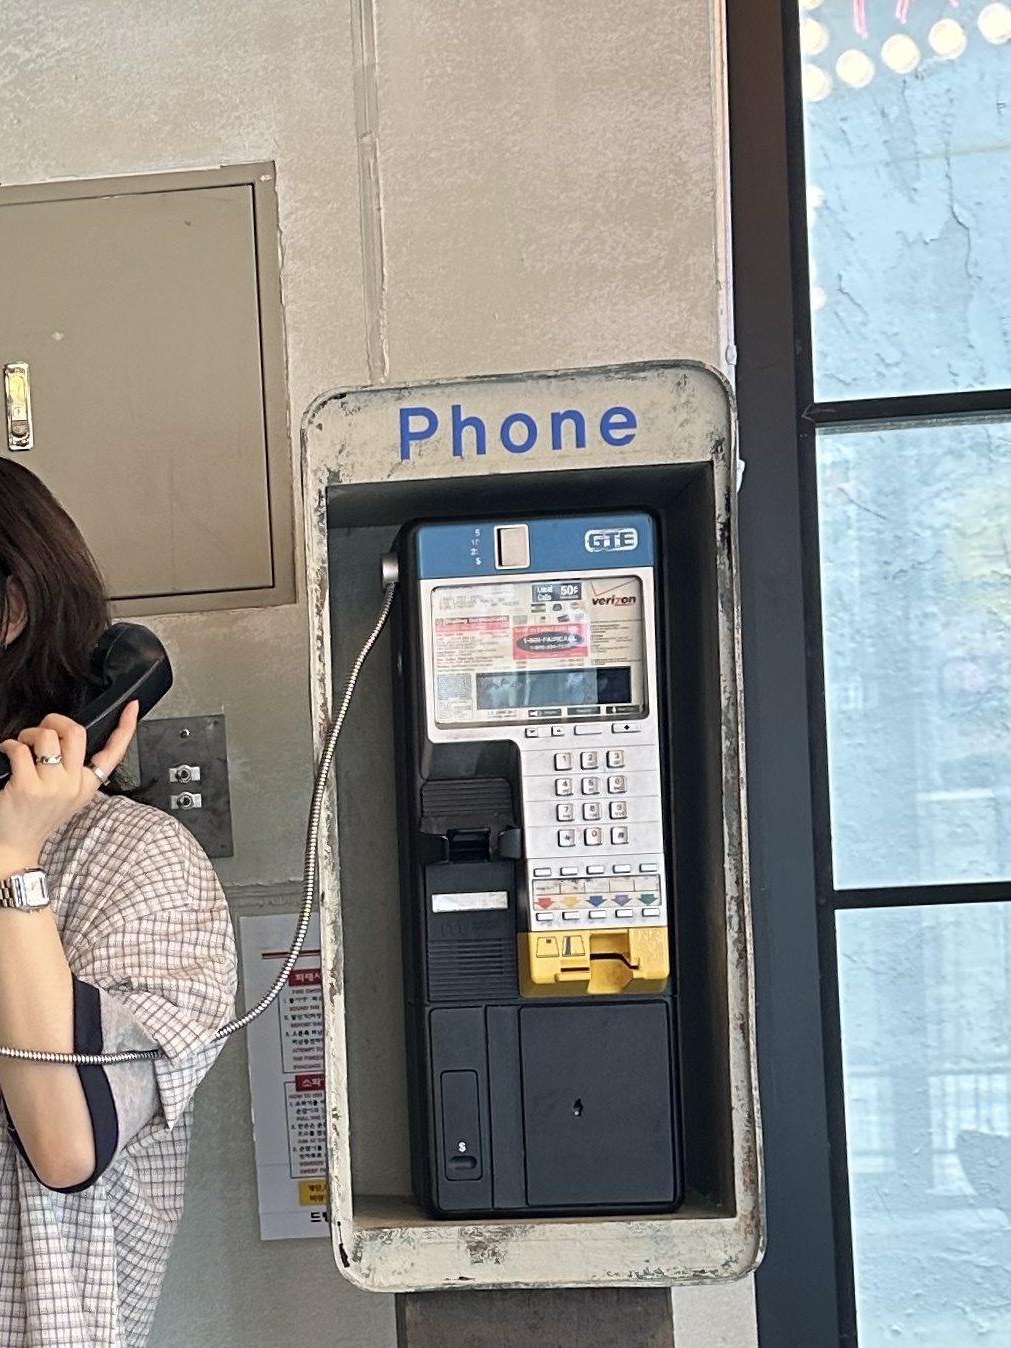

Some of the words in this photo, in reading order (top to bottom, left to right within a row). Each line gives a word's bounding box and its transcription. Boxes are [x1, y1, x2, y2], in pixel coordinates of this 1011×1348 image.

[399, 404, 637, 460] Phone
[588, 532, 635, 549] GTE
[560, 584, 579, 595] 50¢
[592, 594, 637, 606] verizon
